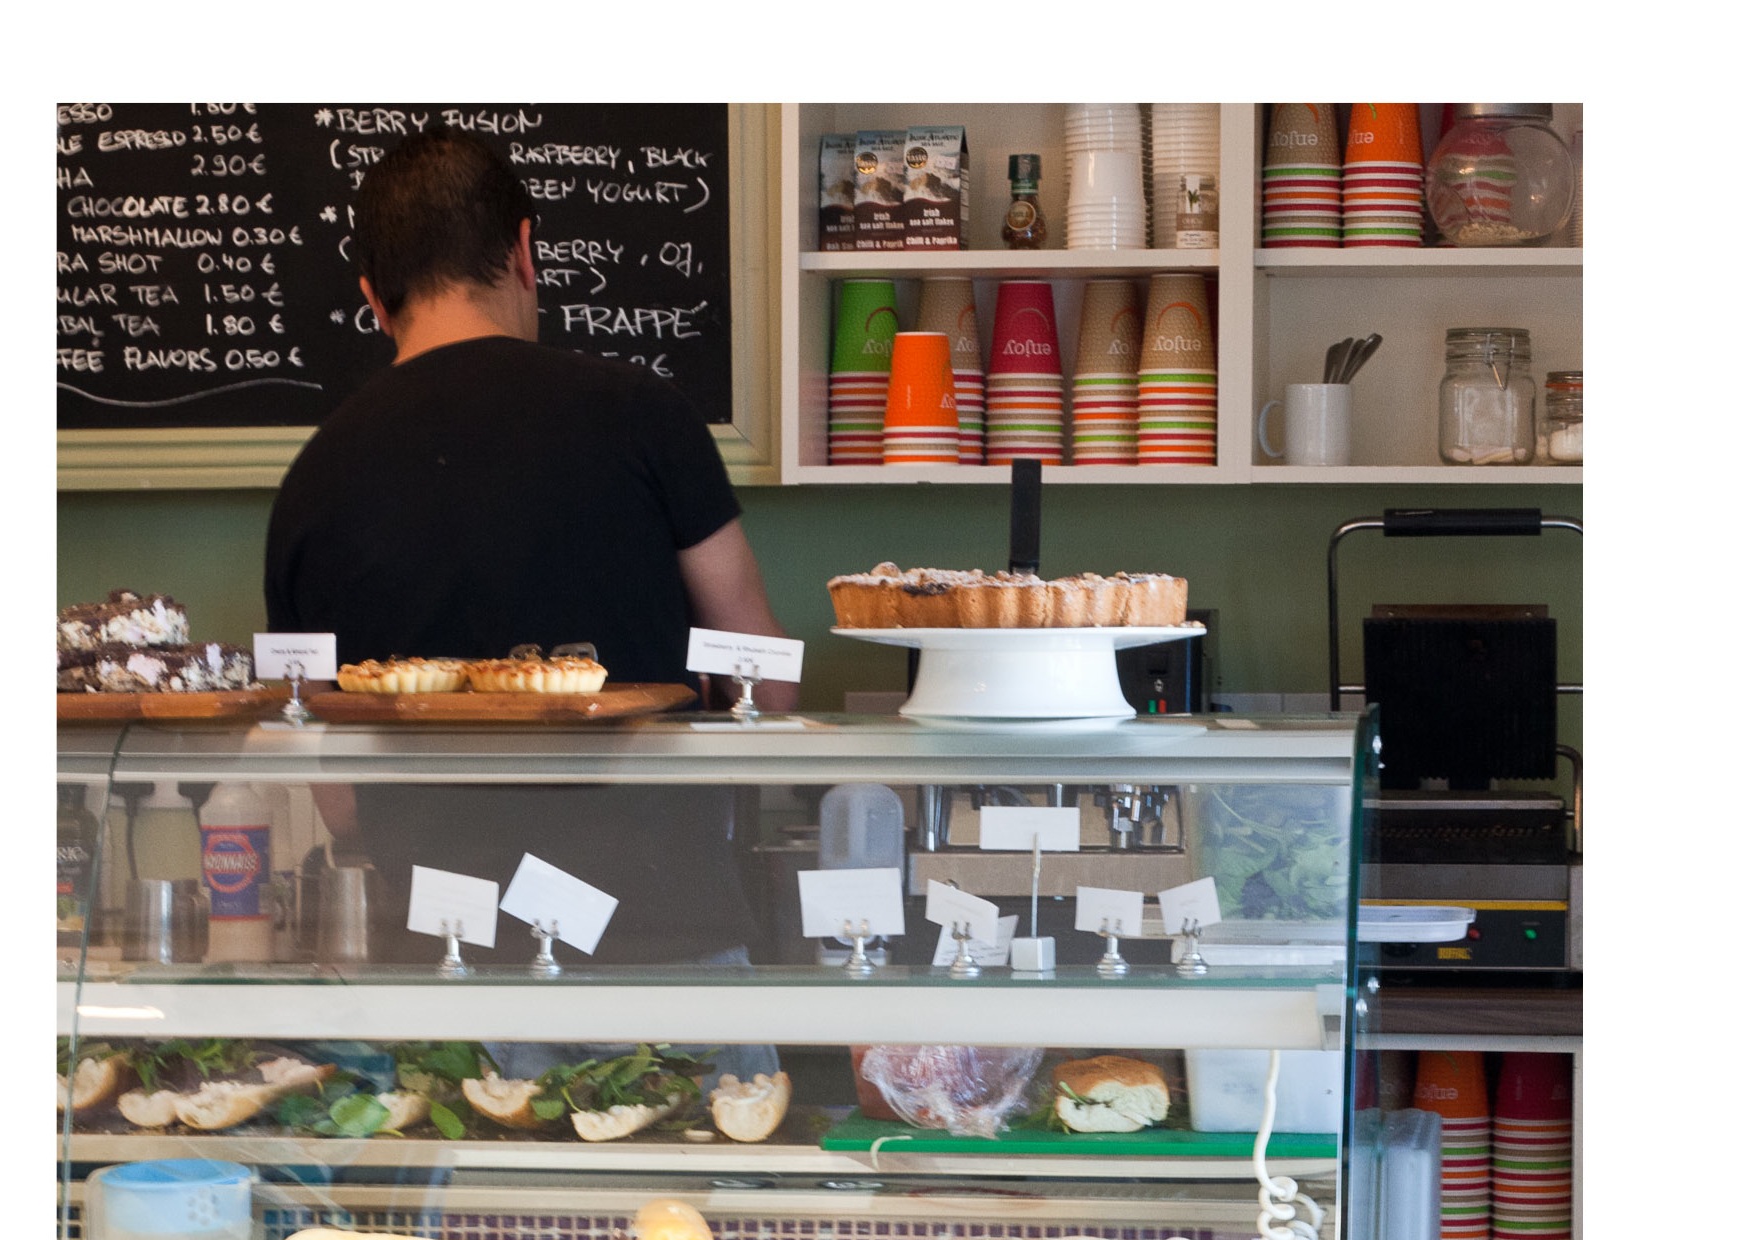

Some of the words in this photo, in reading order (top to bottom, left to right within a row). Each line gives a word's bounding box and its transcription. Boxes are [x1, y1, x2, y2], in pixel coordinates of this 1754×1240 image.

[441, 109, 542, 135] FUSION
[97, 129, 186, 151] ESPRESSO
[640, 146, 713, 168] BLACK
[66, 195, 189, 218] CHOCOLATE
[71, 224, 222, 248] MARSHMALLOW
[98, 251, 163, 274] SHOT
[129, 285, 179, 307] TEA
[112, 313, 161, 337] TEA
[1003, 339, 1052, 357] enjoy
[1153, 335, 1202, 354] enjoy
[123, 346, 218, 372] FLAVORS
